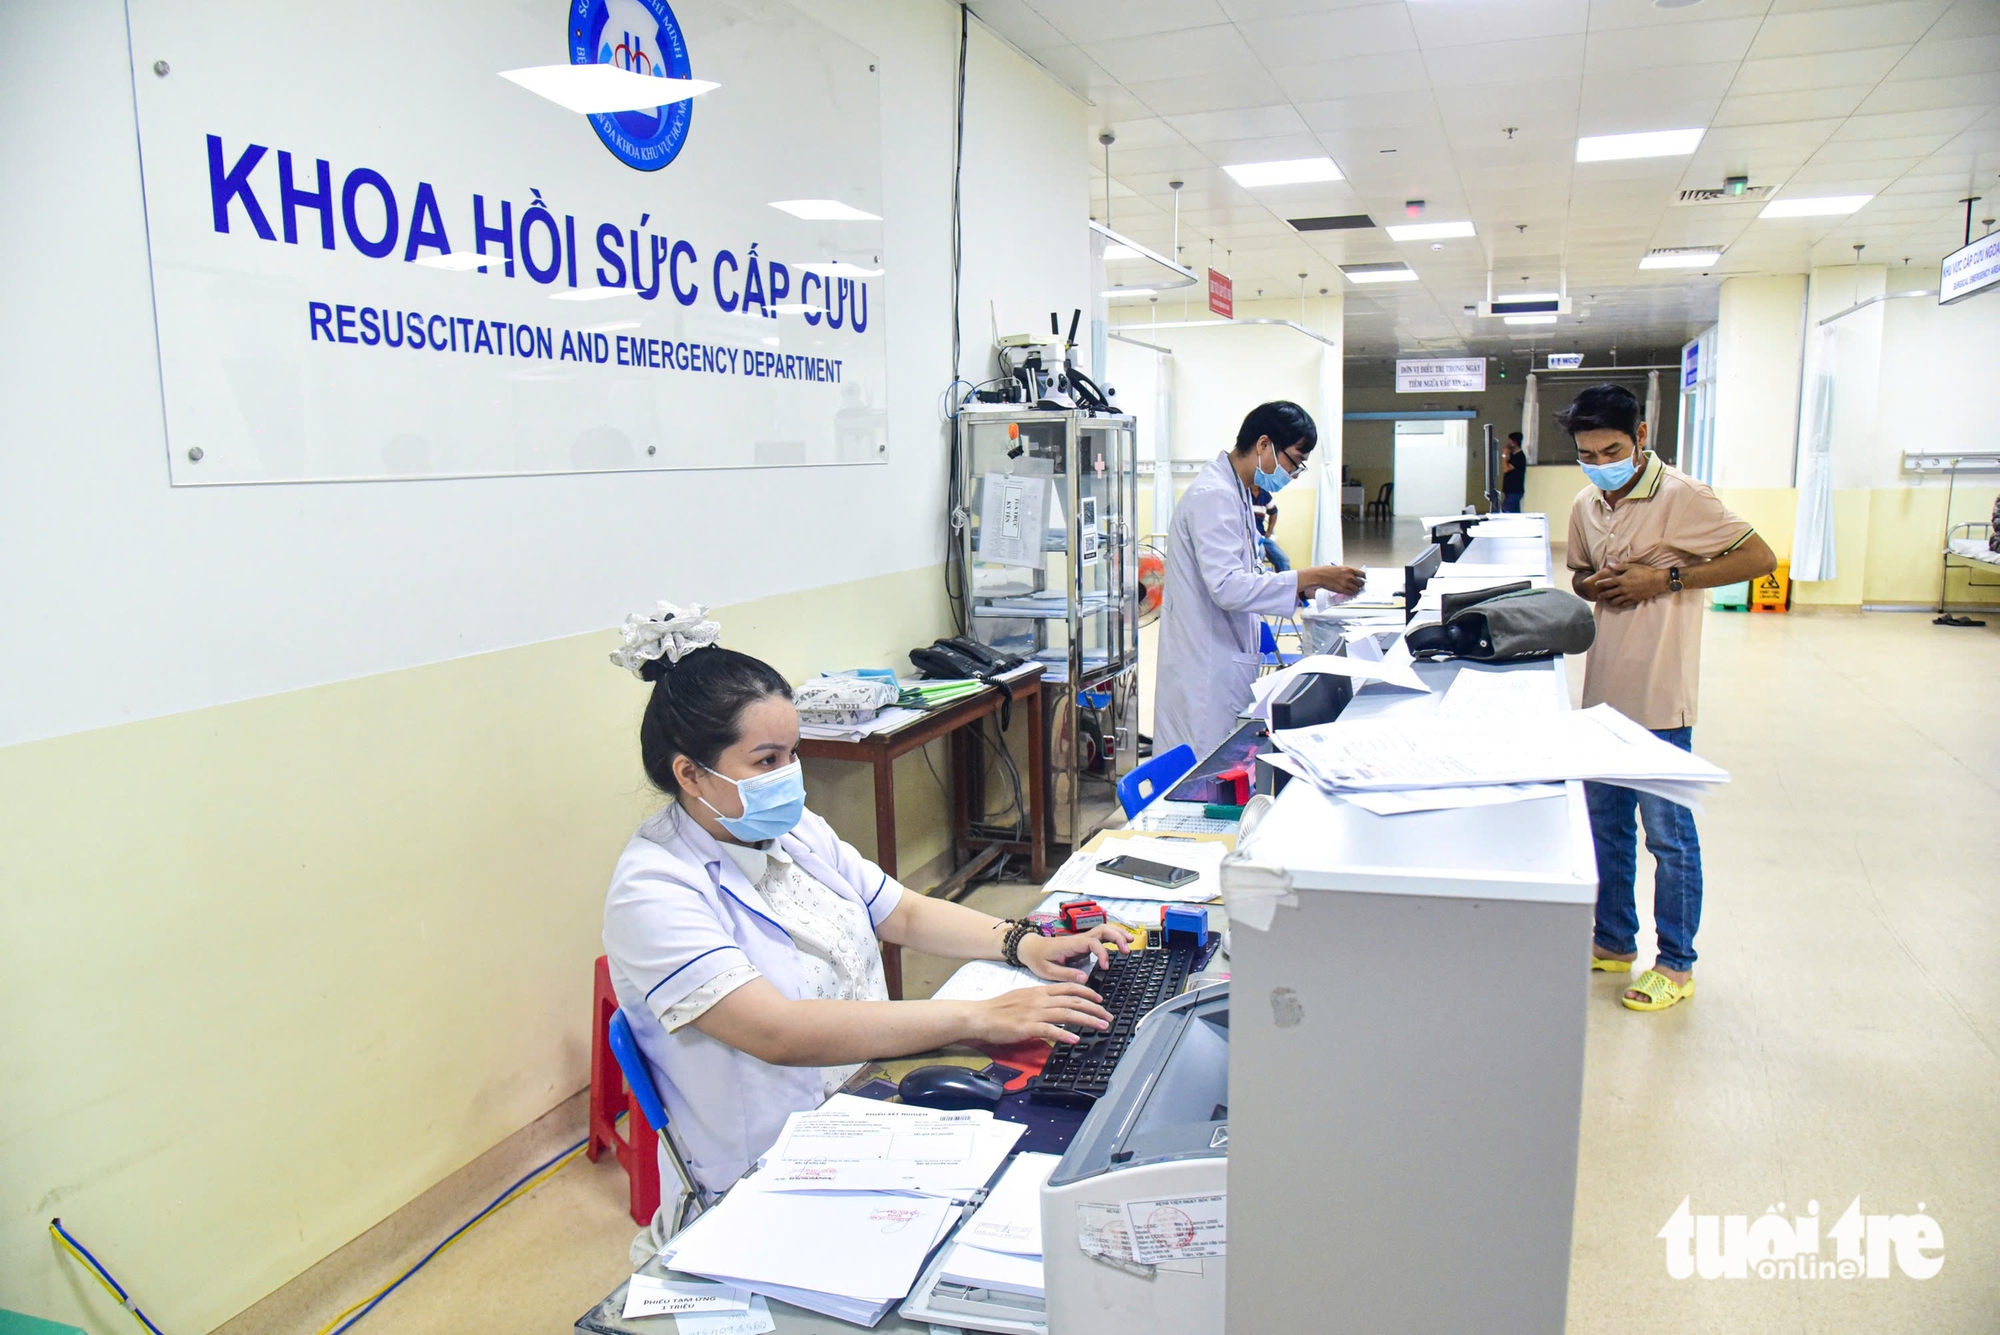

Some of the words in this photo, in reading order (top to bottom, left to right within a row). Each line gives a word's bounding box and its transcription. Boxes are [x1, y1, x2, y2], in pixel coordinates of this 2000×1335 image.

[662, 16, 682, 58] MINH
[616, 137, 640, 160] KHOA
[641, 147, 659, 161] KHU
[206, 133, 452, 262] KHOA
[473, 187, 577, 288] HỒI
[596, 213, 698, 306] SỨC
[713, 242, 790, 319] CẤP
[309, 301, 553, 360] RESUSCITATION
[560, 329, 609, 364] AND
[616, 335, 738, 375] EMERGENCY
[743, 349, 842, 383] DEPARTMENT
[643, 1297, 671, 1306] PHIẾU
